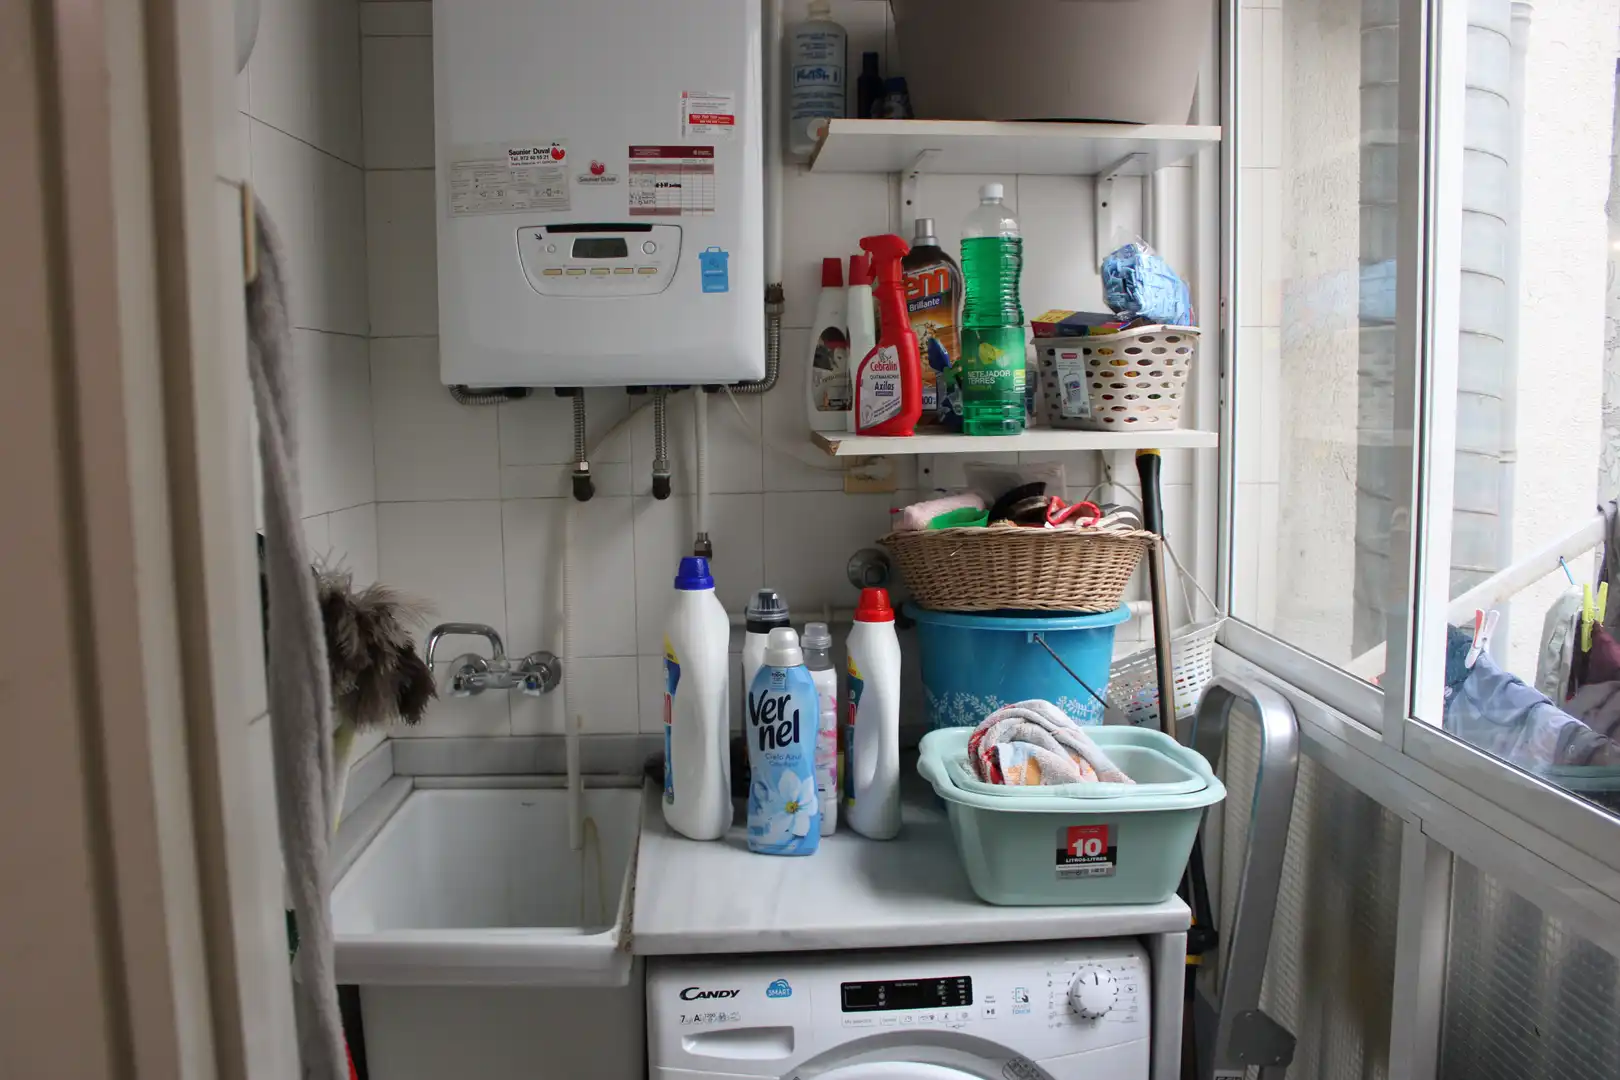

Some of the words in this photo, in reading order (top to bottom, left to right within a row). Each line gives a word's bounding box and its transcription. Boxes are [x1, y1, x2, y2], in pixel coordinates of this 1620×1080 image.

[904, 268, 949, 300] enn
[909, 298, 940, 312] Brillante
[870, 361, 897, 372] Cebralin
[967, 370, 1011, 378] NETEJADOR
[874, 381, 894, 391] Axilas
[967, 377, 995, 385] TERRES
[749, 689, 791, 726] Ver
[759, 709, 800, 751] nel
[1072, 838, 1102, 857] 10
[768, 988, 791, 996] SMART
[680, 1015, 686, 1023] 7
